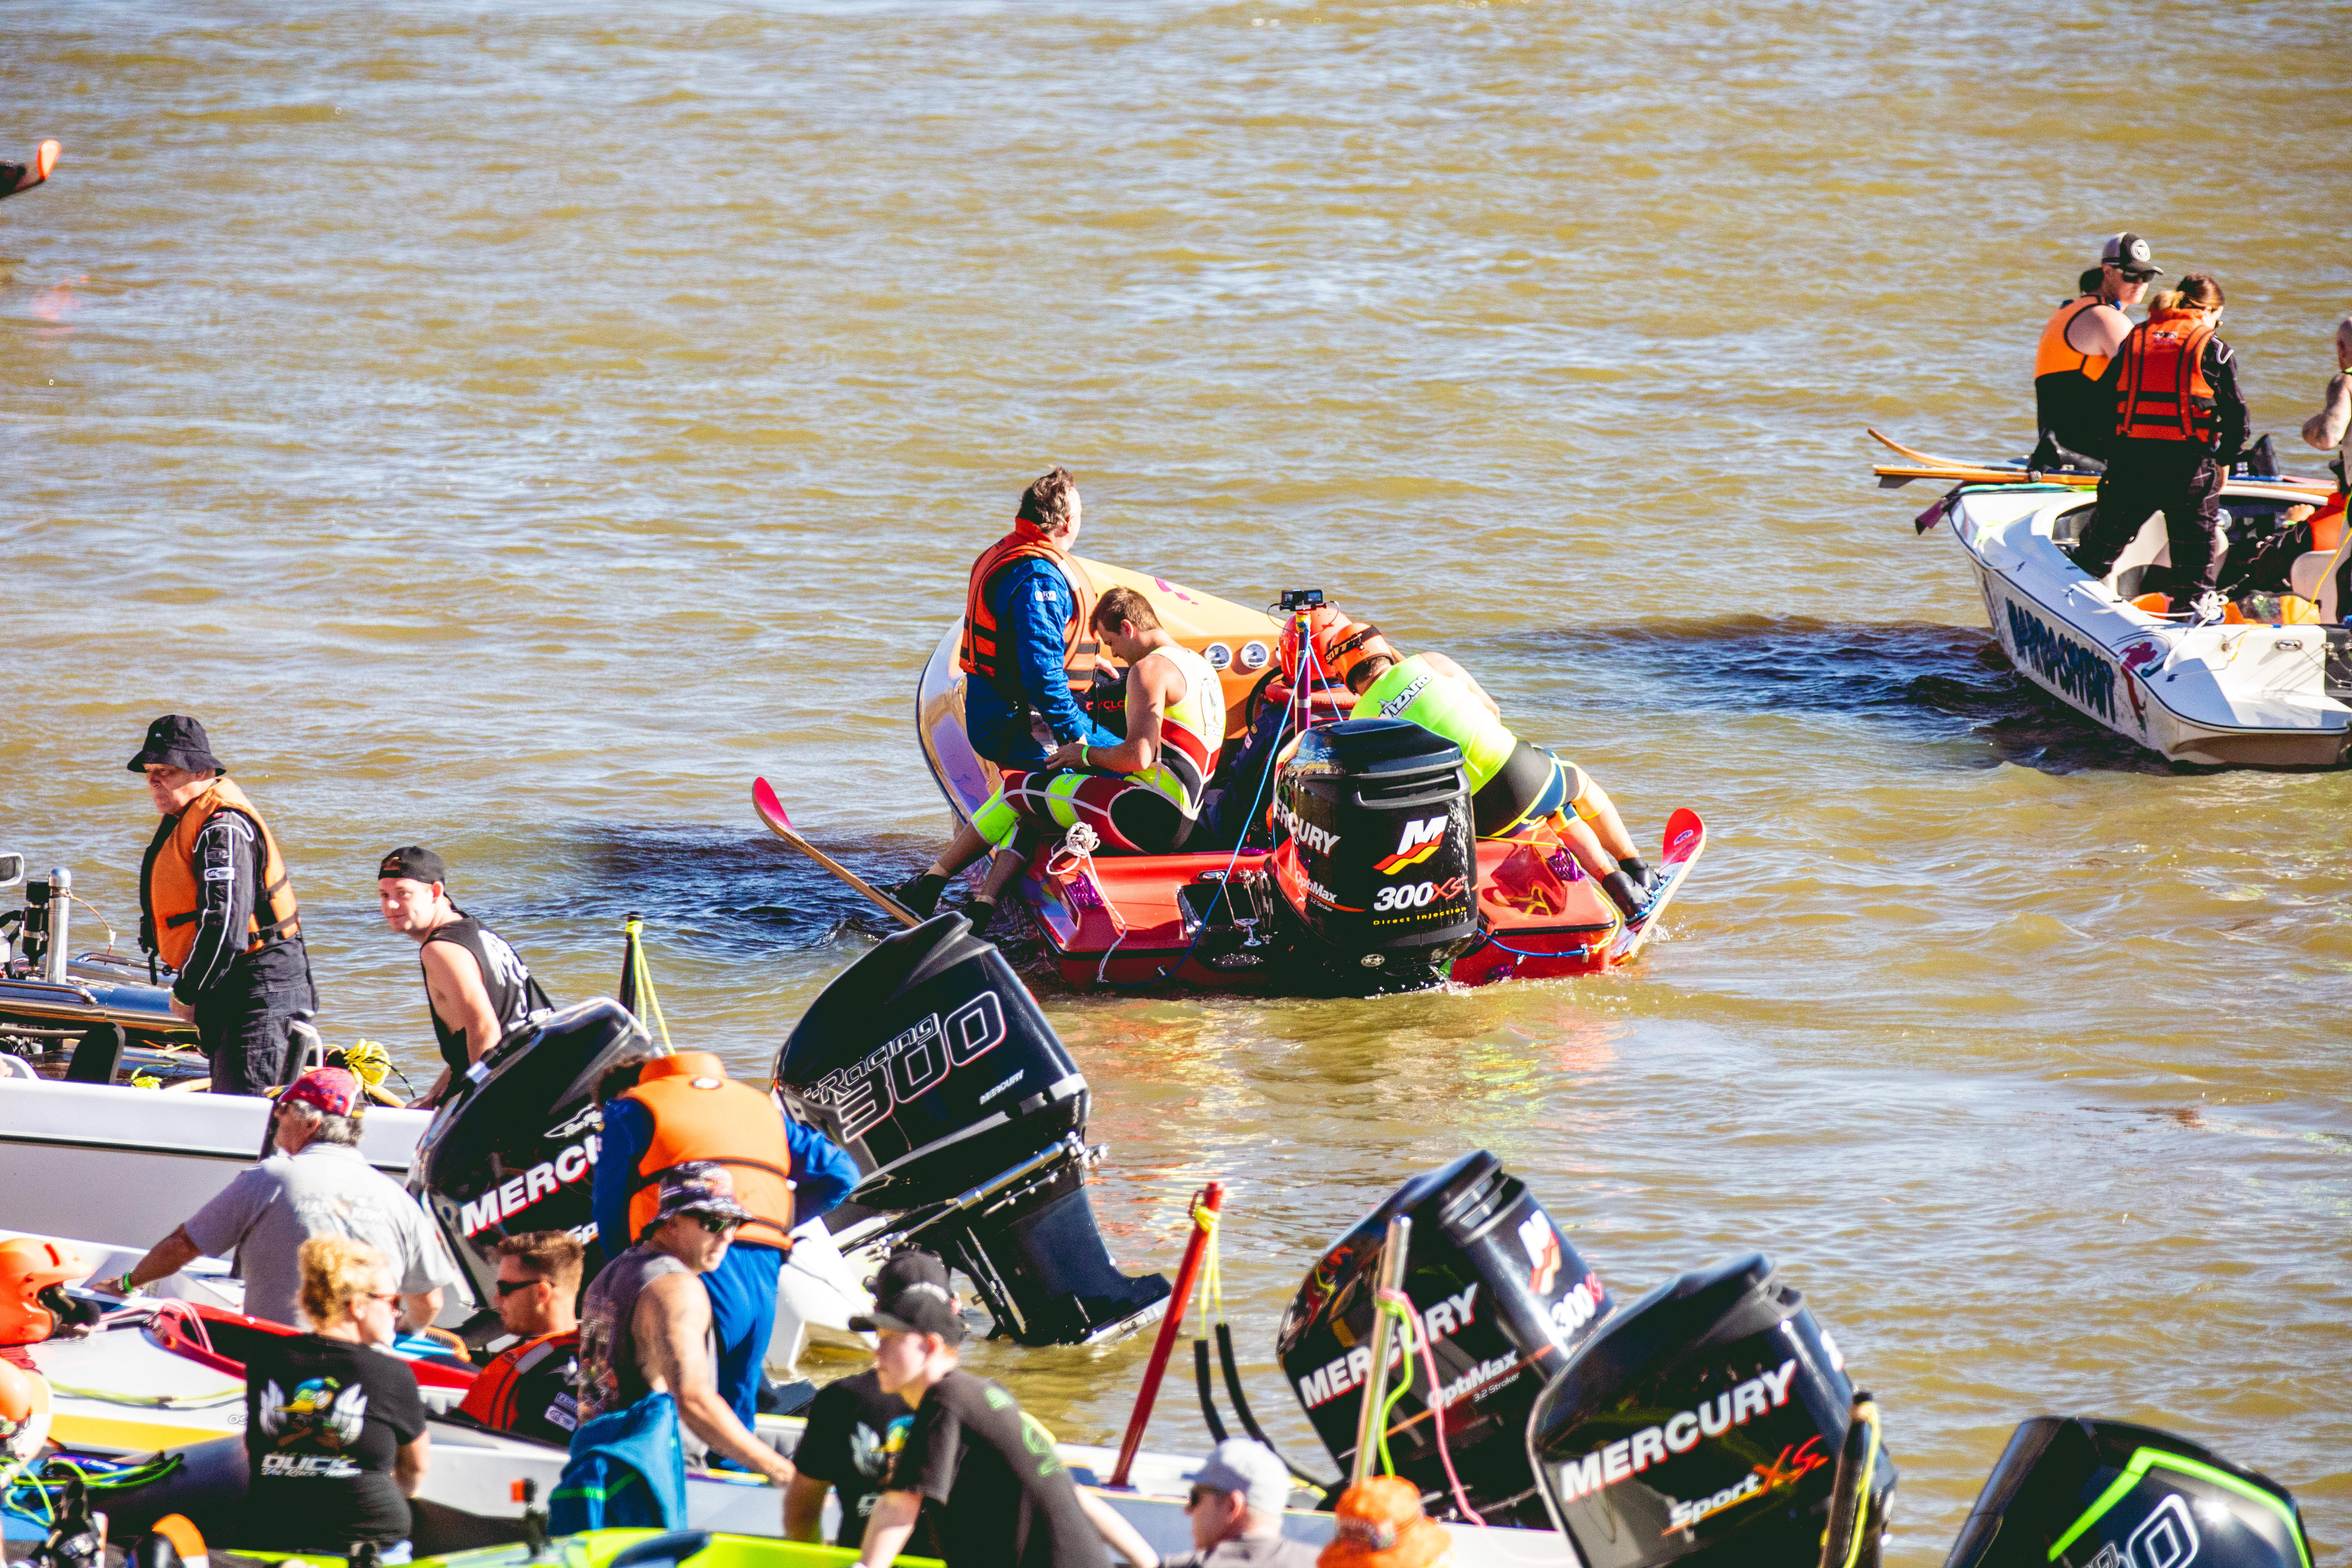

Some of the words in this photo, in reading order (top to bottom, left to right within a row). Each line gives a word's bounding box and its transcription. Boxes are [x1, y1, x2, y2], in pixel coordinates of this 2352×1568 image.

[1275, 798, 1341, 856] ERCURY
[1295, 871, 1337, 904] OptiMax
[1373, 917, 1410, 925] Direct
[818, 1012, 941, 1105] Racing
[839, 990, 1008, 1143] 300
[979, 1068, 1024, 1105] MERCURY
[1427, 1350, 1518, 1409] OptiMax
[1474, 1389, 1488, 1403] 3.2
[1488, 1372, 1521, 1395] Stroker
[1560, 1359, 1797, 1502] MERCURY
